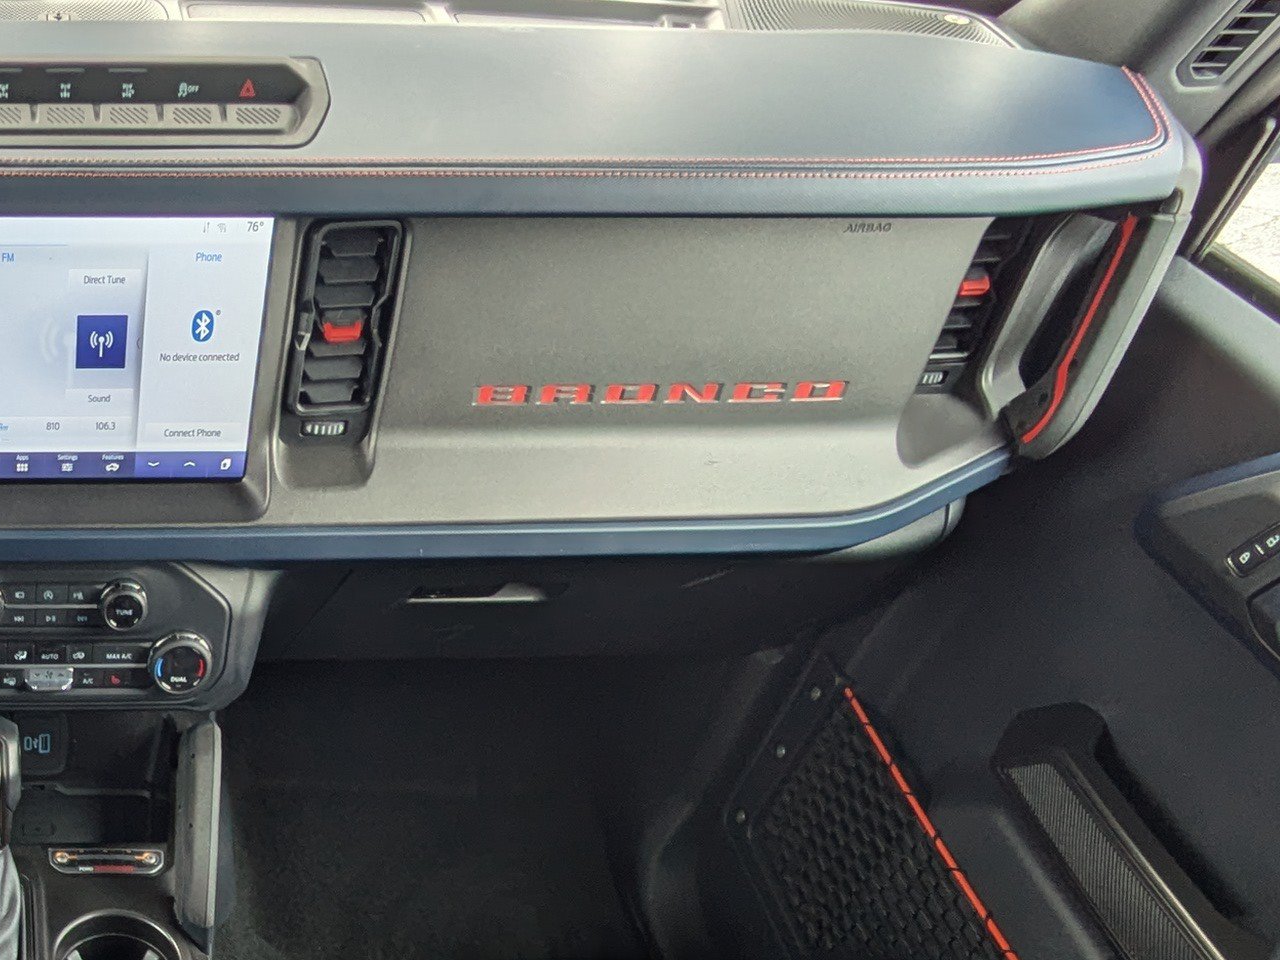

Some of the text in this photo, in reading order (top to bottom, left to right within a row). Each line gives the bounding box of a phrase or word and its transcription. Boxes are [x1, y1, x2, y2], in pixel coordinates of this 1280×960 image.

[247, 221, 264, 232] 76°
[843, 222, 892, 233] AIRBAG
[1, 253, 14, 262] FM
[195, 252, 223, 262] Phone
[83, 275, 126, 285] Direct Tune
[159, 353, 240, 361] No device connected
[472, 380, 849, 405] BRONCO
[88, 394, 111, 403] Sound
[46, 422, 60, 431] 810
[95, 422, 116, 431] 106.3
[164, 428, 222, 437] Connect Phone
[15, 454, 29, 462] Apps
[57, 454, 78, 462] Settings
